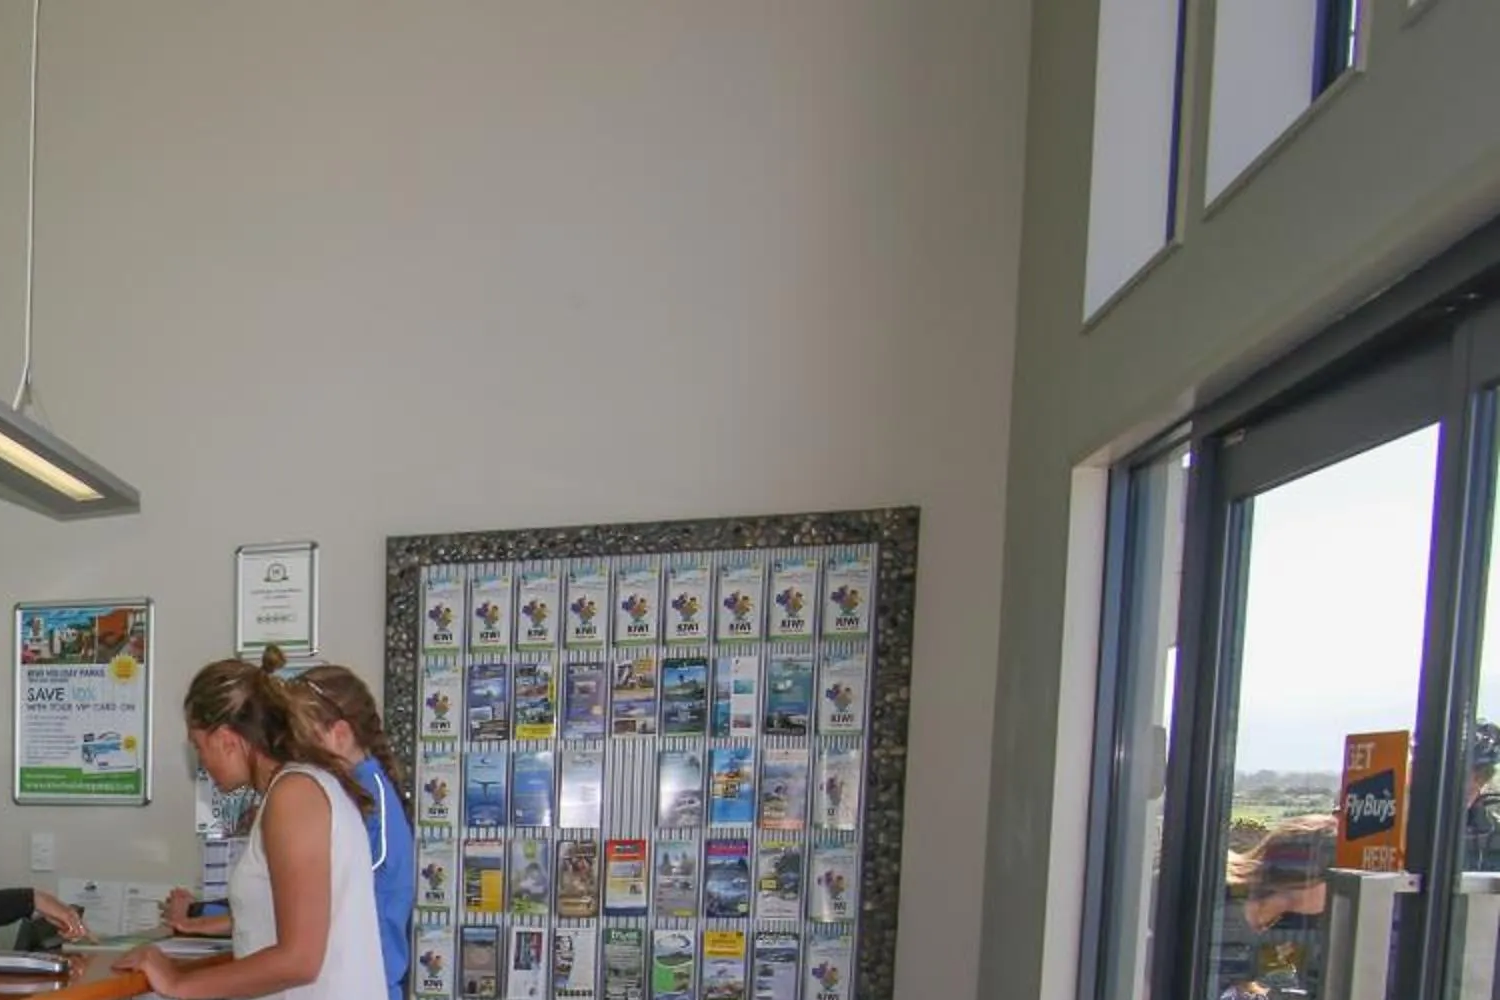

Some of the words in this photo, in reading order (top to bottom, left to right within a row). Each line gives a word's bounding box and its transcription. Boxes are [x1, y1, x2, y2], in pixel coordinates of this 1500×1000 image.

[627, 624, 649, 634] KIWI
[27, 687, 65, 702] SAVE
[1344, 788, 1396, 823] FlyBuys
[1362, 845, 1397, 872] HERE
